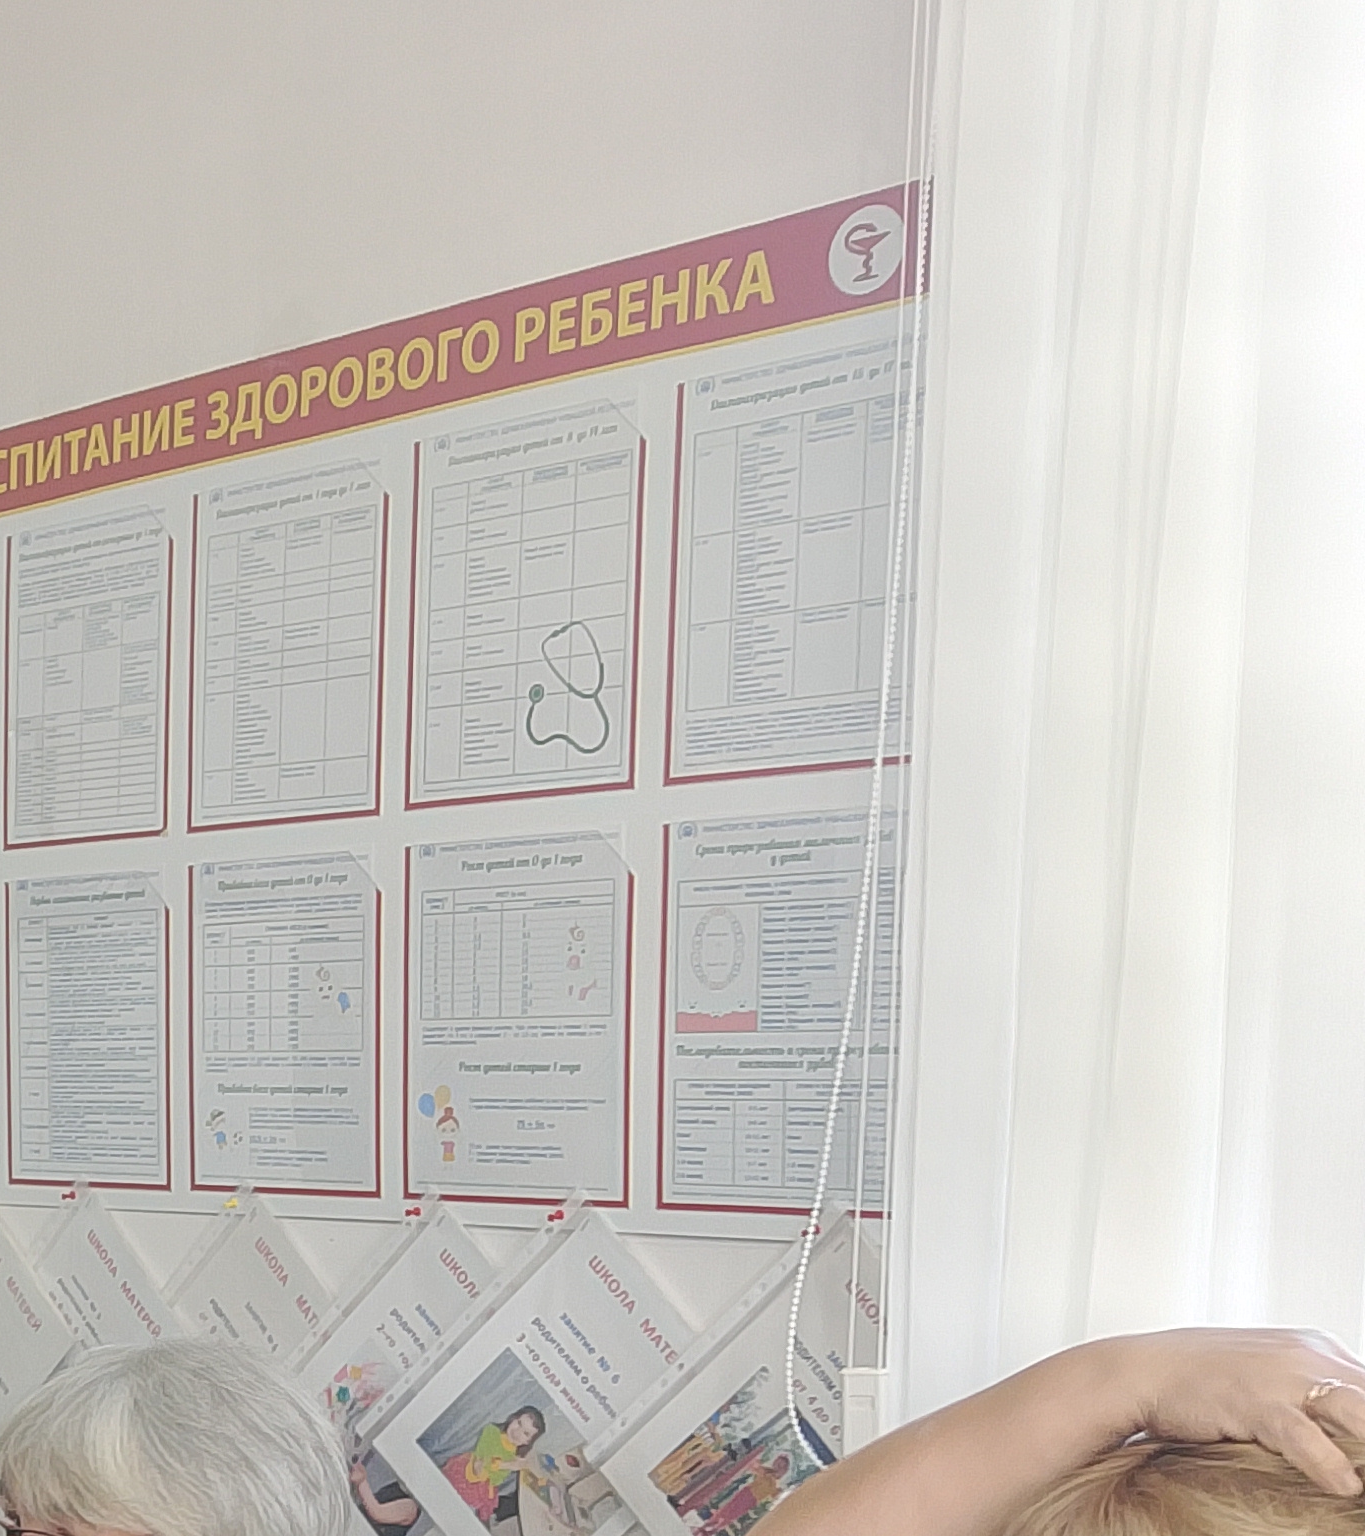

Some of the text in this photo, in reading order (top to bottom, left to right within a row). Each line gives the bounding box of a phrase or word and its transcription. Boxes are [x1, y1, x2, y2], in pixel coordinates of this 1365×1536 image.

[205, 319, 500, 446] ЗДОРОВОГО
[513, 249, 776, 363] РЕБЕНКА
[87, 1228, 119, 1278] ШКОЛА
[254, 1236, 319, 1330] ШКОЛА МАТ
[588, 1254, 681, 1366] ШКОЛА МАТЕ
